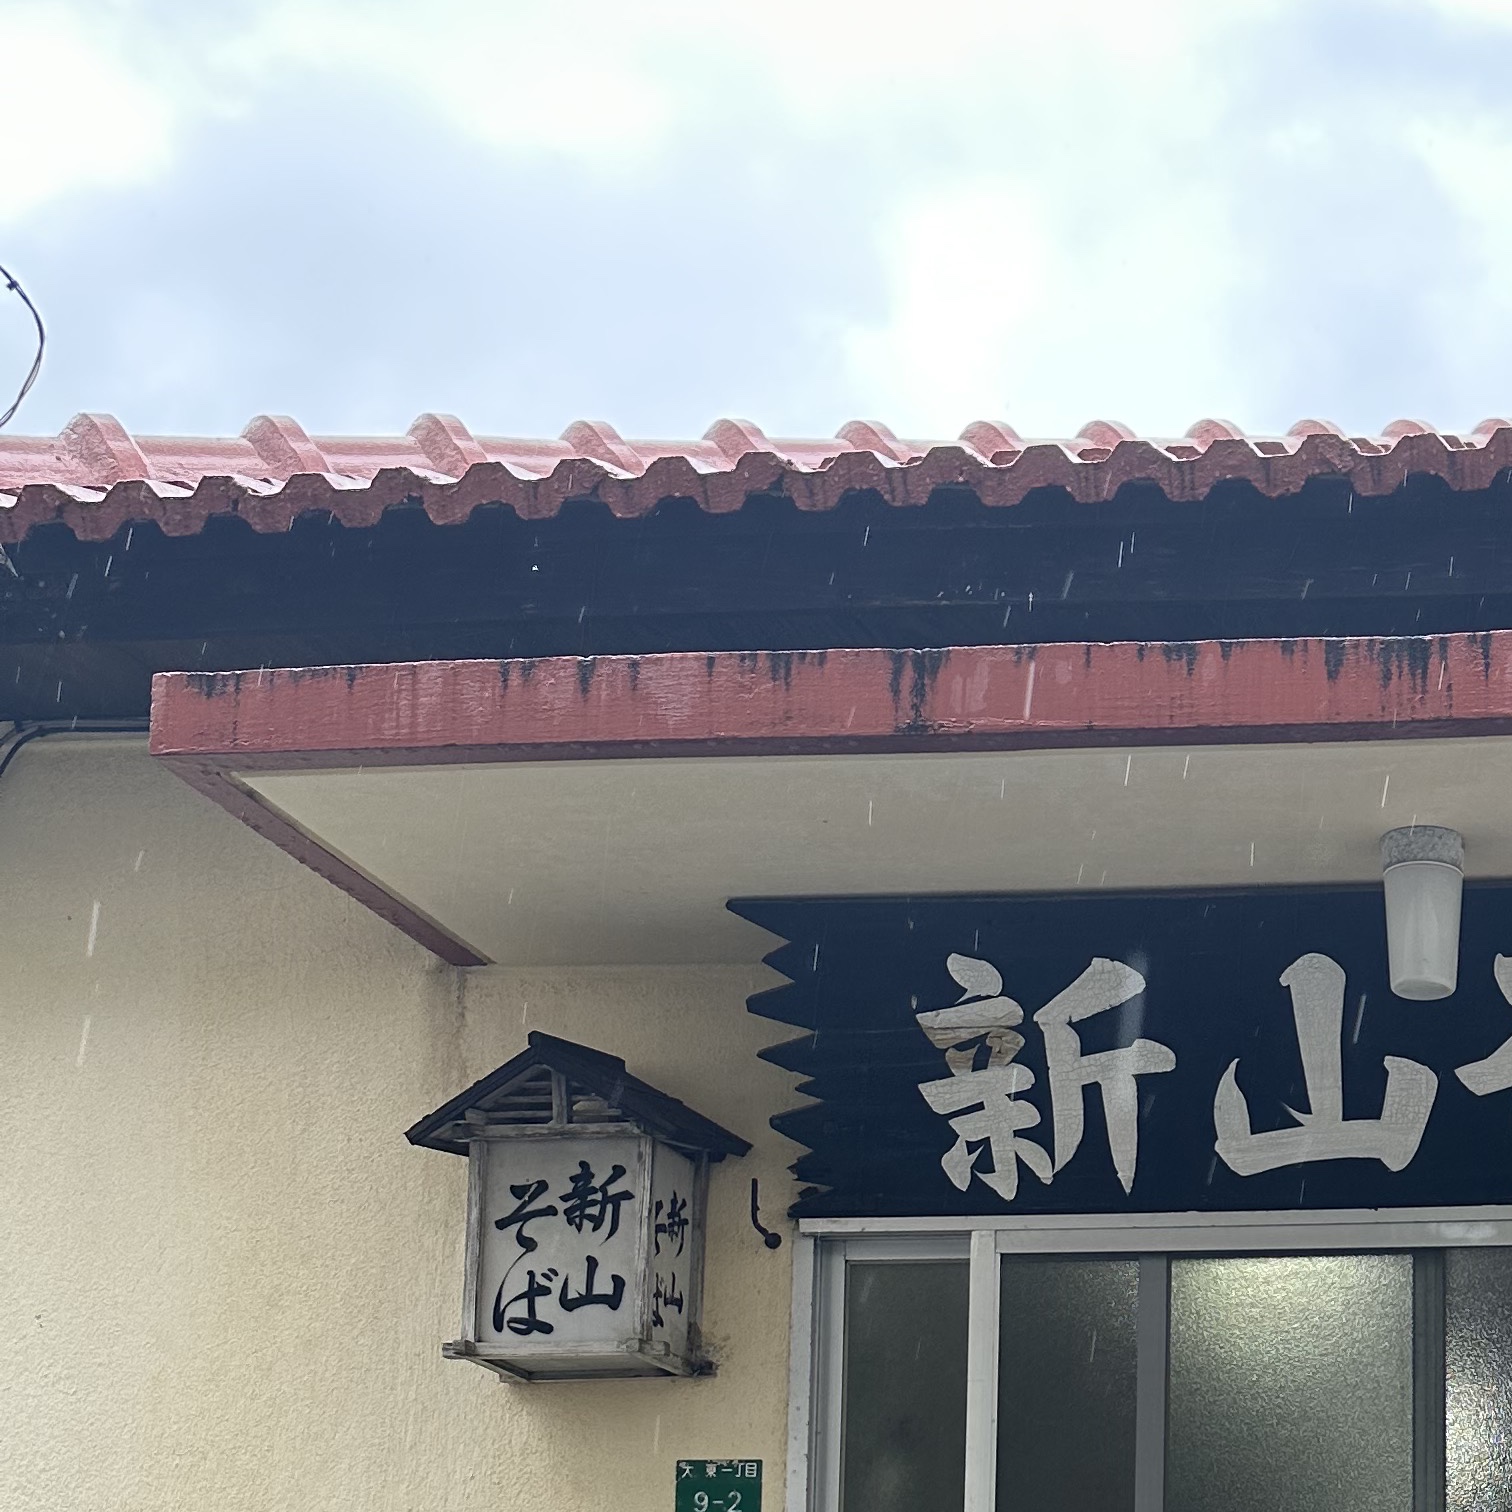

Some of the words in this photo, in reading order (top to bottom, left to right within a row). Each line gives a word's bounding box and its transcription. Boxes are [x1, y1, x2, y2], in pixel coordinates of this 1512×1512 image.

[493, 1179, 559, 1335] そば
[558, 1160, 635, 1312] 新山
[693, 1491, 742, 1512] 9-2
